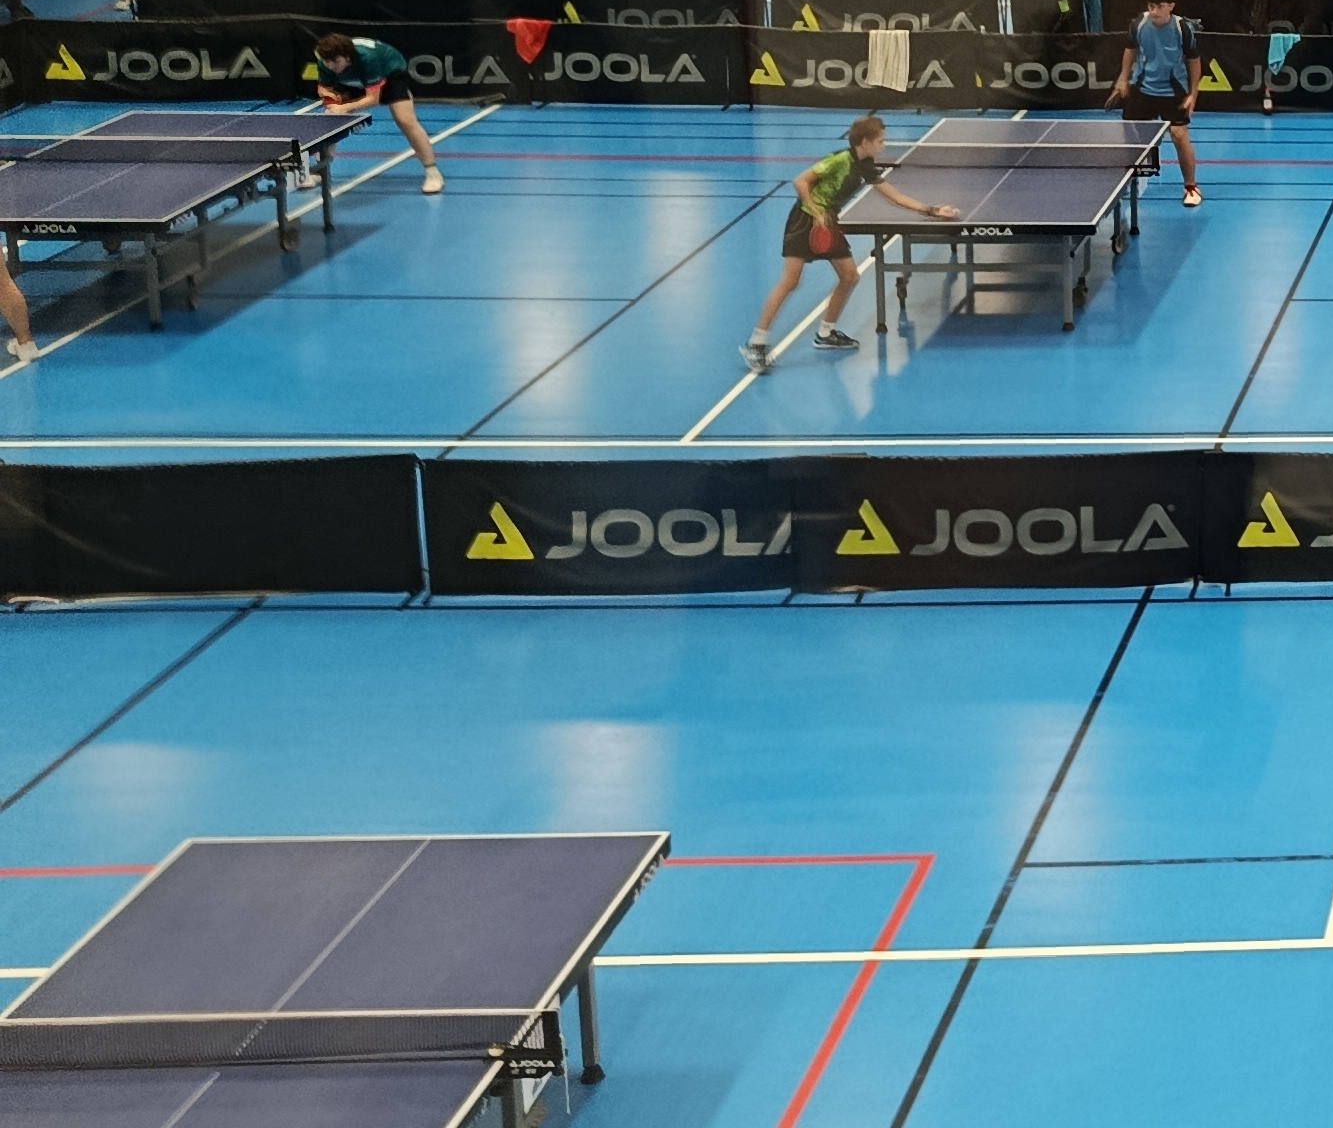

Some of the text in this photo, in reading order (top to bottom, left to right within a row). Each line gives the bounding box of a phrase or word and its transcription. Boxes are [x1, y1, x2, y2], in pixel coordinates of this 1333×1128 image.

[94, 46, 271, 81] JOOLA
[545, 52, 706, 84] JOOLA
[32, 224, 77, 234] JOOLA
[971, 227, 1014, 236] JOOLA
[910, 502, 1190, 556] JOOLA
[520, 1059, 556, 1068] JOOLA
